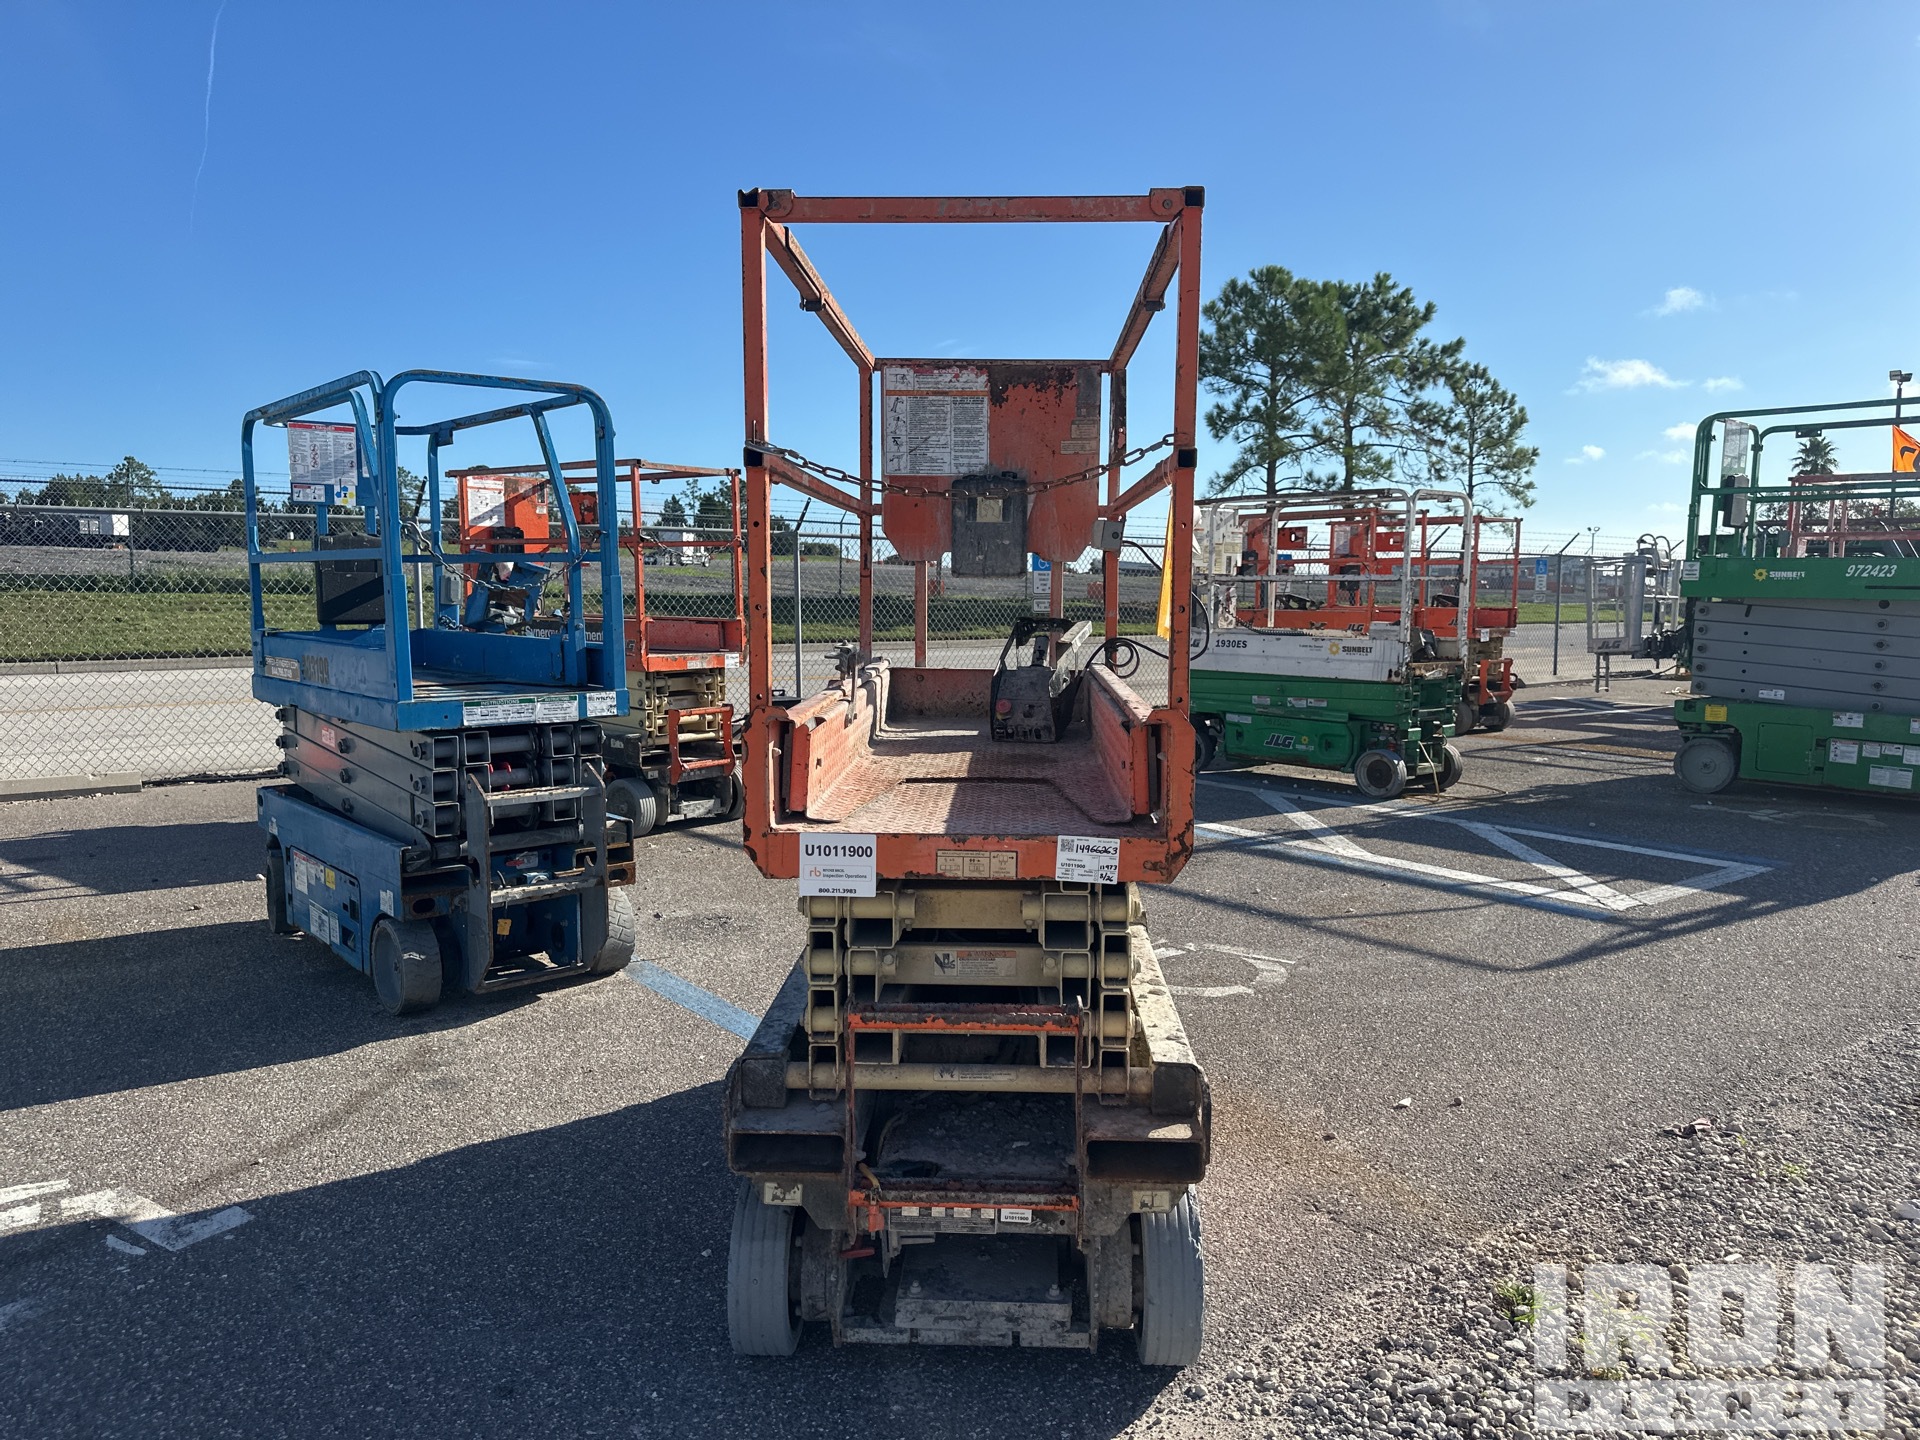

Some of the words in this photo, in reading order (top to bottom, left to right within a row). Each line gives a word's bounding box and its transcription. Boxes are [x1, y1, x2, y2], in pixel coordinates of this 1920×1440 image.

[1845, 564, 1898, 577] 972423
[1347, 623, 1365, 631] JLG
[1215, 639, 1248, 649] 1930ES
[1597, 640, 1622, 650] JLG
[1342, 646, 1373, 654] SUNBELT
[1264, 733, 1296, 749] JLG
[805, 844, 873, 857] U1011900
[809, 867, 821, 877] rb
